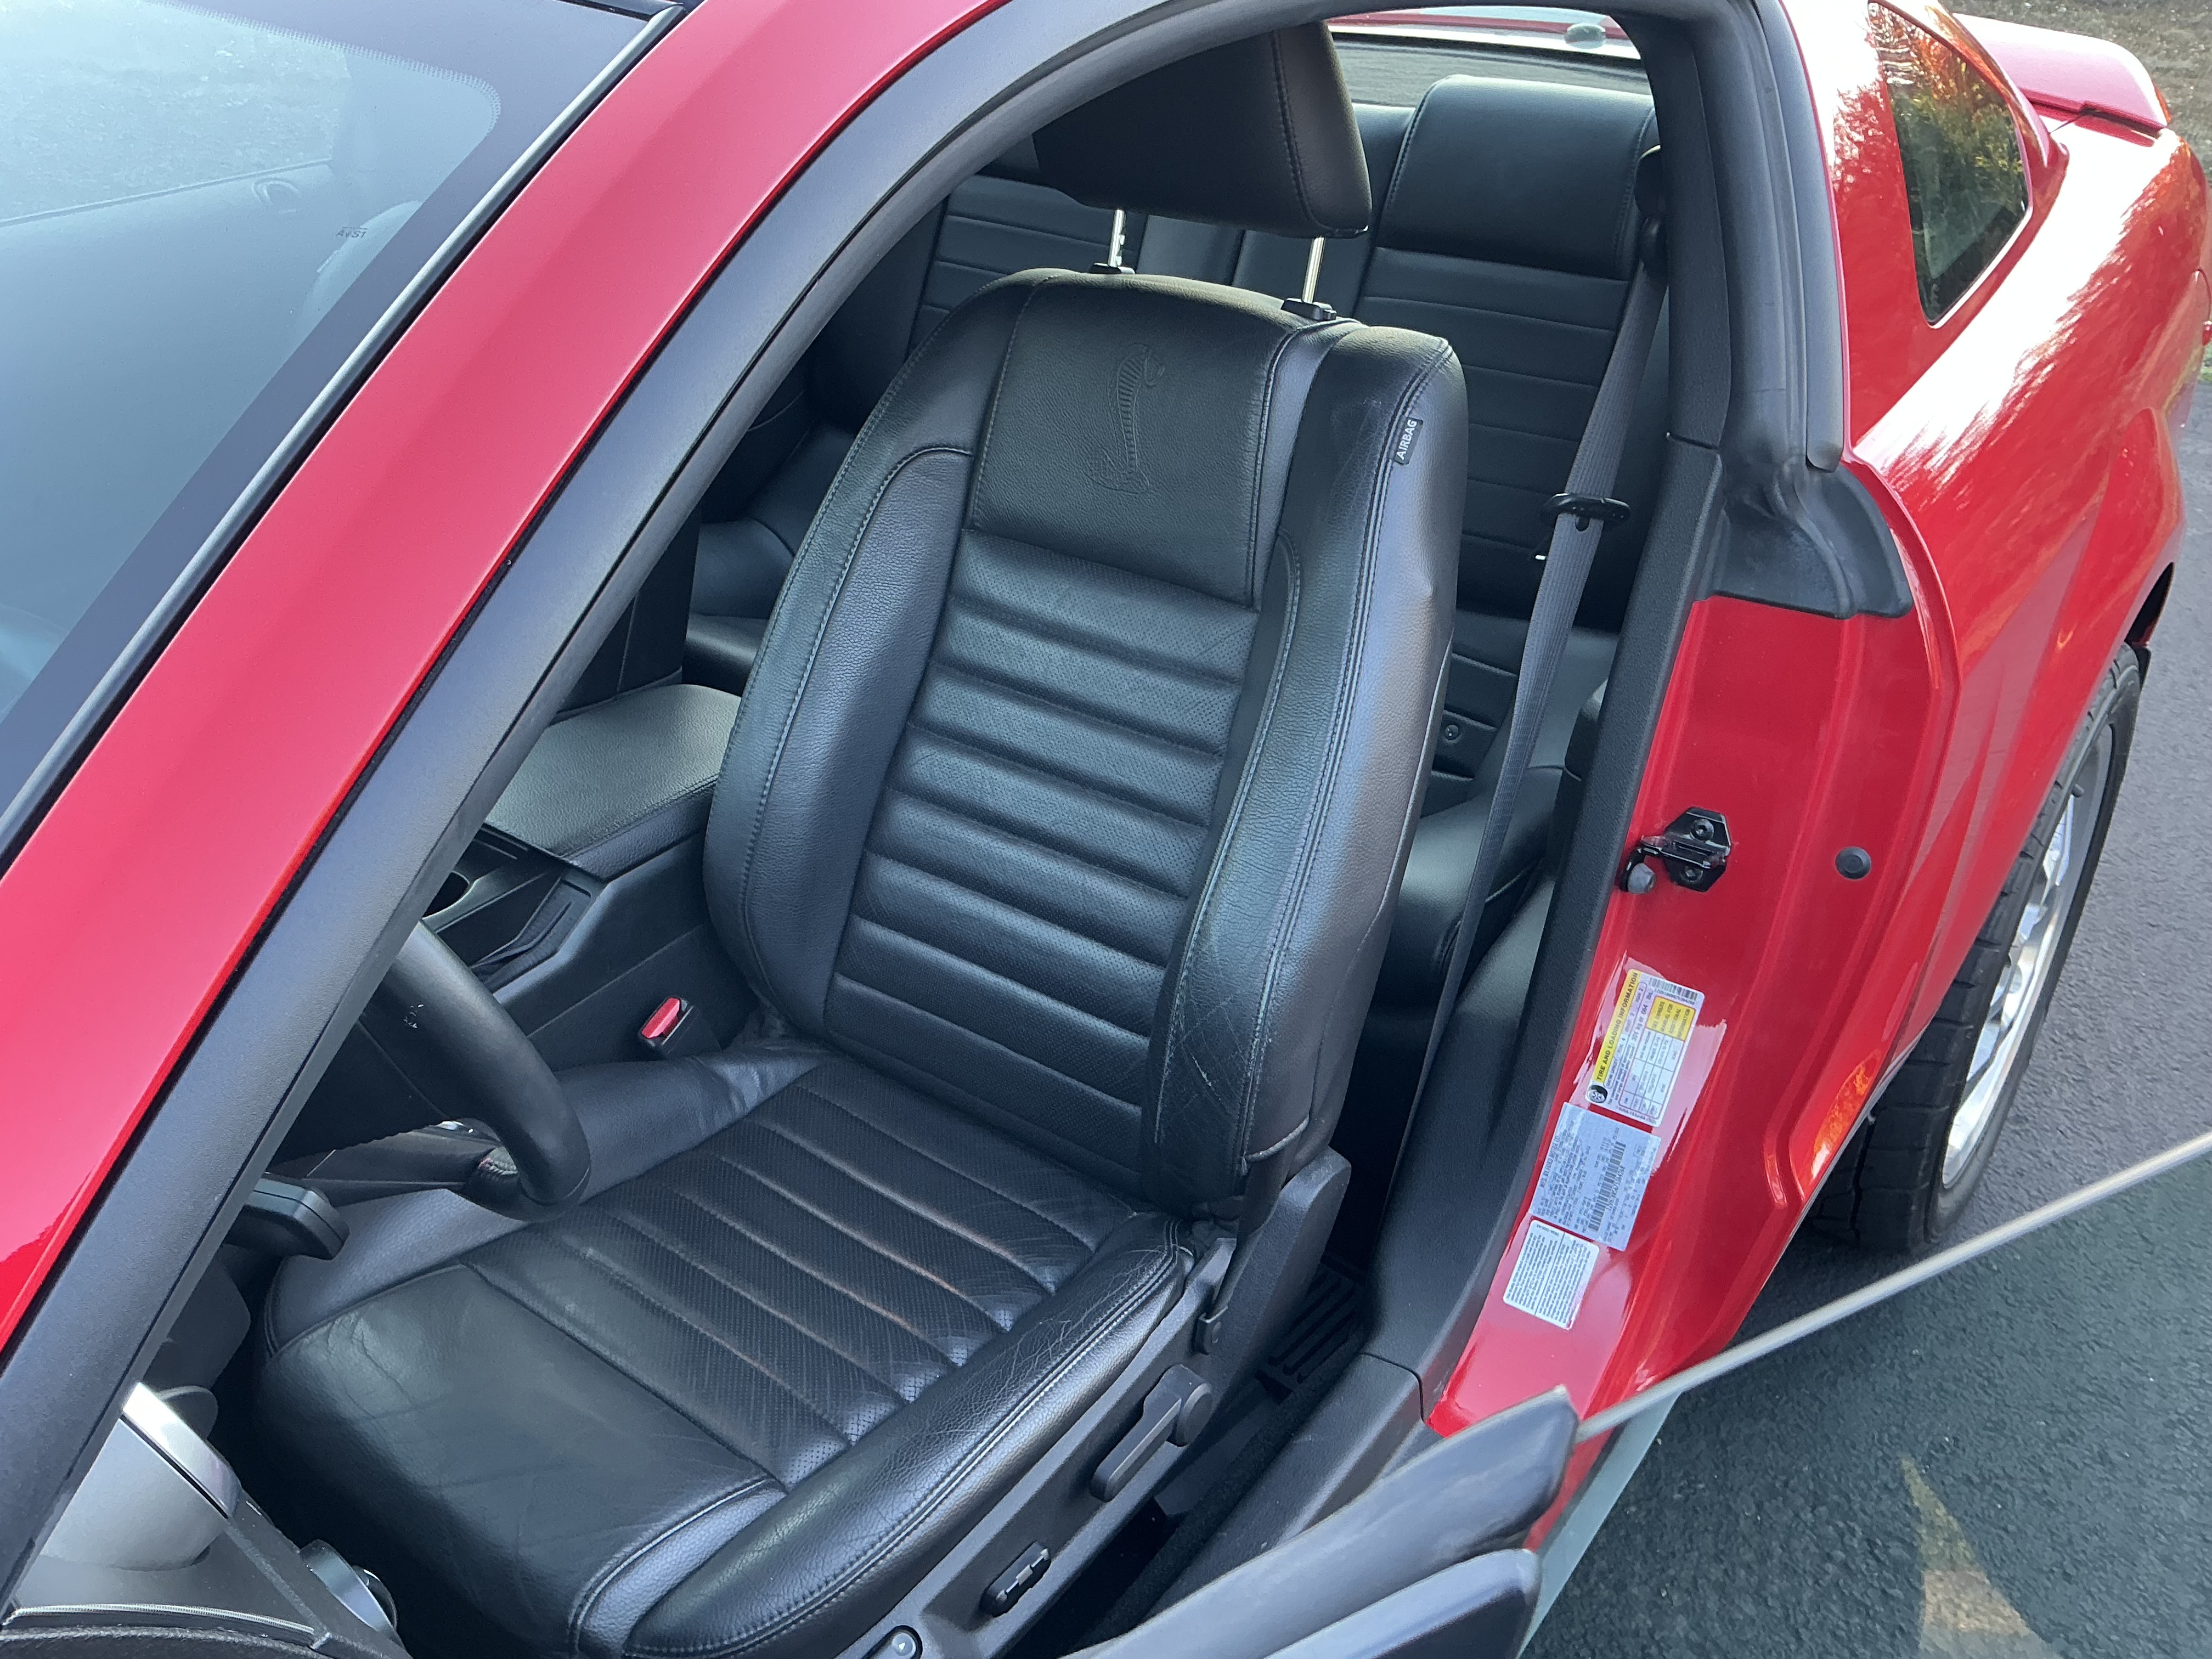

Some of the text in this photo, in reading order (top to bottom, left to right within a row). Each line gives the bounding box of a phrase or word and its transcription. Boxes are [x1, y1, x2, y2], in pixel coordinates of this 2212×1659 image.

[1396, 419, 1417, 460] AIRBAG
[1595, 971, 1638, 1081] TIRE AND LOADING INFORMATION
[1635, 1022, 1643, 1031] kg
